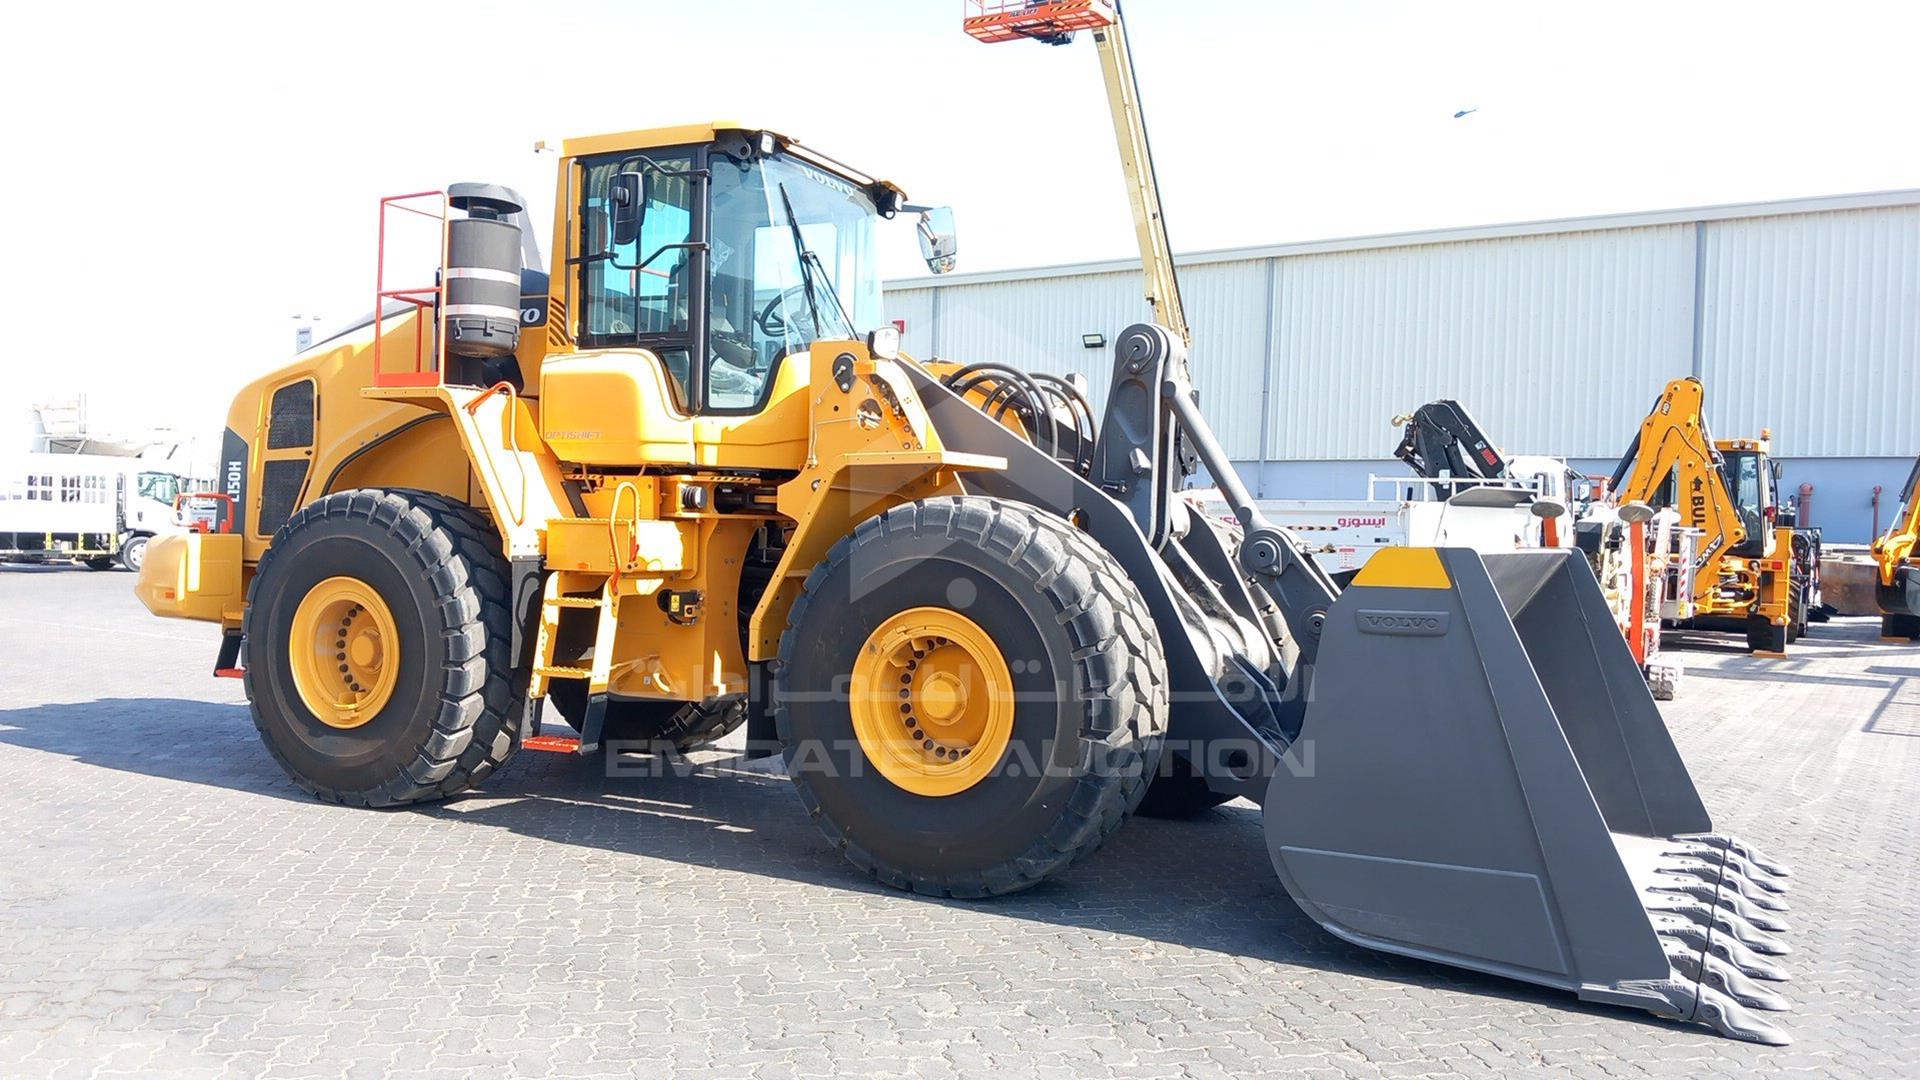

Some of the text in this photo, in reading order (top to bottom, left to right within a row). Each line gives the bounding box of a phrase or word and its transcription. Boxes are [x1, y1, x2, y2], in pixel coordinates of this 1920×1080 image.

[800, 165, 855, 197] VOLVO
[227, 461, 241, 503] L150H
[1364, 615, 1440, 631] VOLVO
